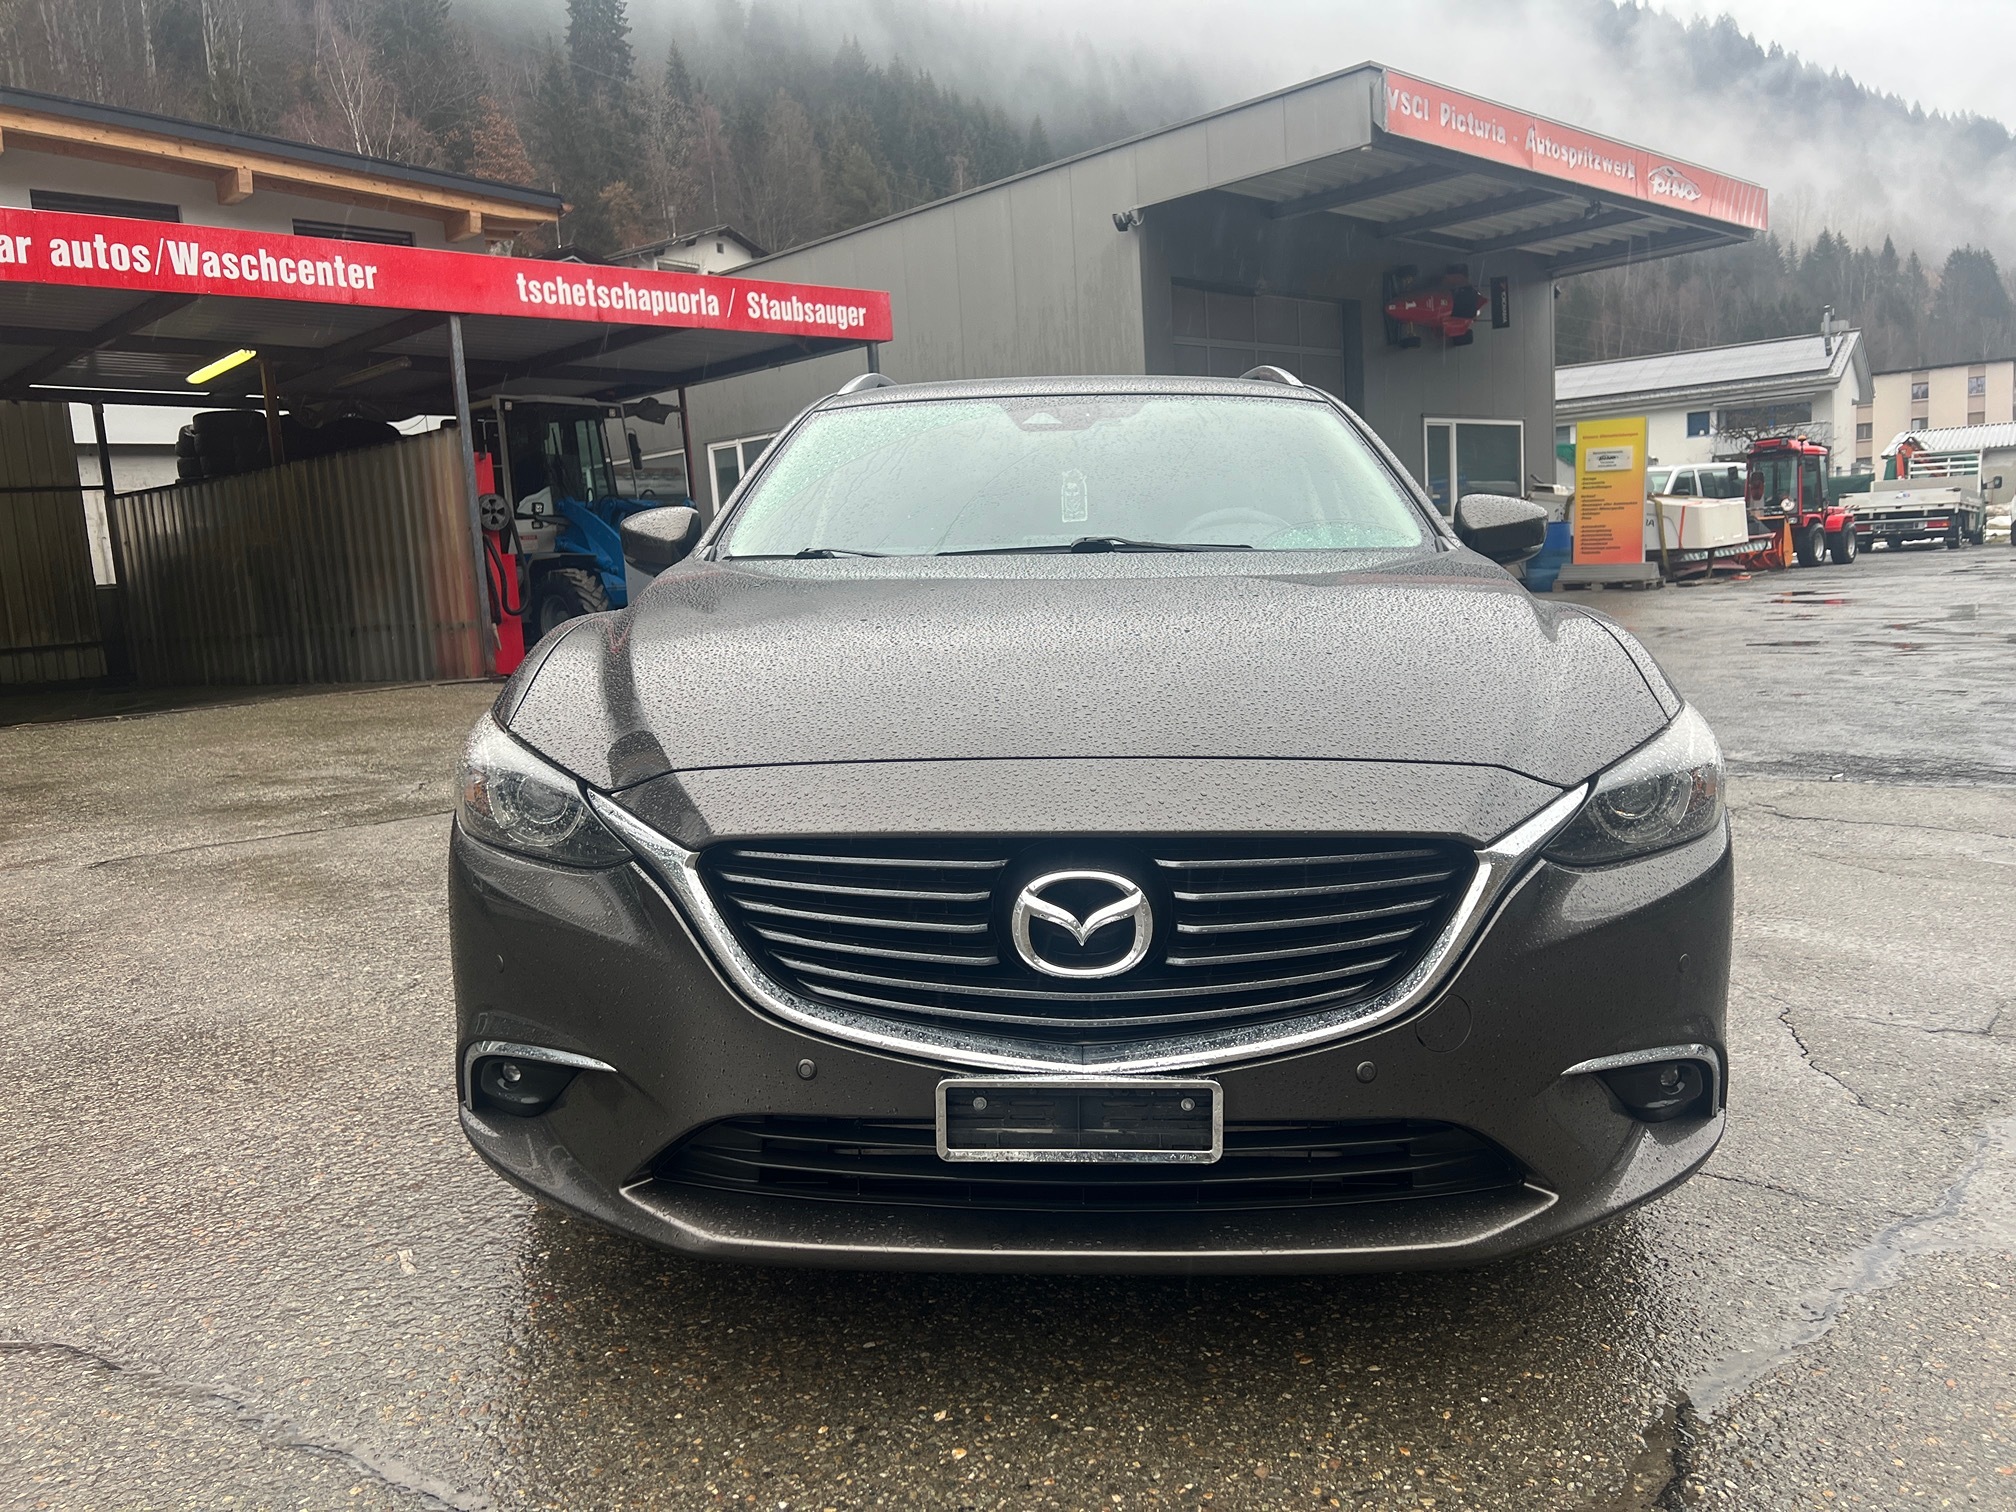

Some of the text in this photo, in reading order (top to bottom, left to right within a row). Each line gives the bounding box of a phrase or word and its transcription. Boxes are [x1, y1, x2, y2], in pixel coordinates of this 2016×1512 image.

[1387, 86, 1429, 121] VSCI
[1440, 102, 1506, 145] Picturia
[1525, 127, 1636, 180] Autospritzwerk
[0, 234, 32, 264] ar
[516, 272, 867, 330] tschetschapuorla / Staubsauger
[1405, 301, 1416, 310] 1
